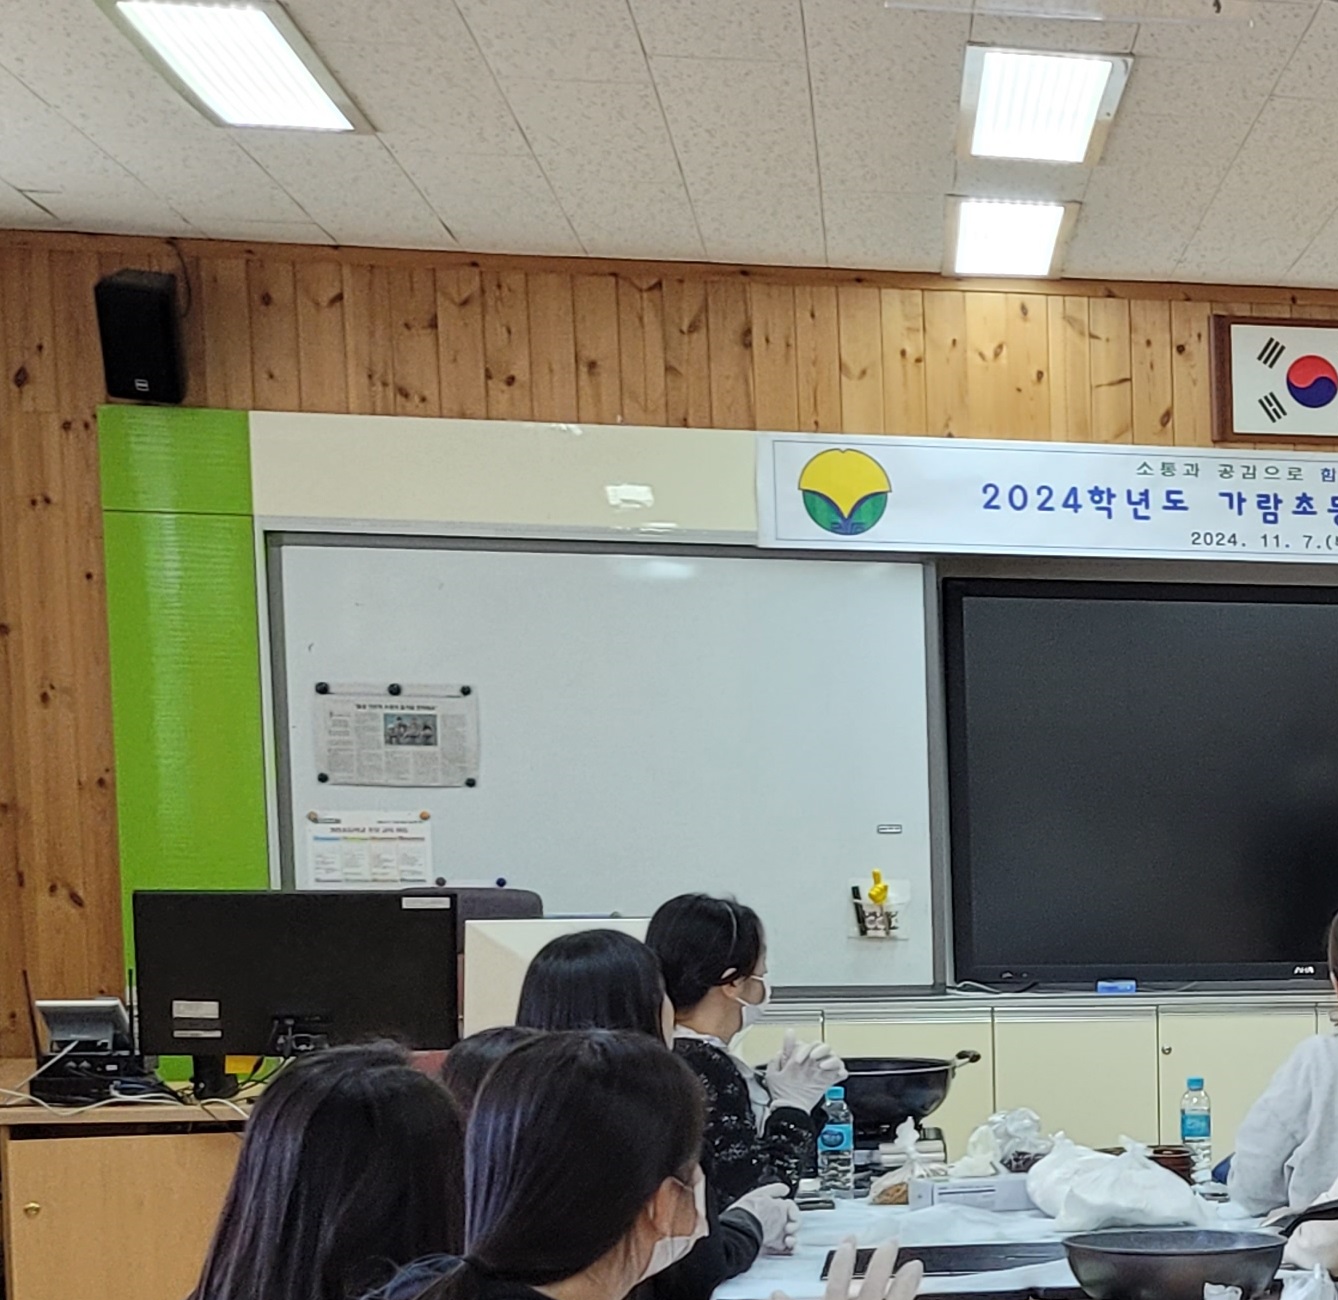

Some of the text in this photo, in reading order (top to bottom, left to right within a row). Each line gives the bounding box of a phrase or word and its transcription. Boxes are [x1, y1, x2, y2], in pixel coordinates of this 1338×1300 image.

[1135, 461, 1200, 478] 소통과
[1218, 464, 1304, 481] 공감으로
[982, 482, 1190, 521] 2024학년도
[1190, 532, 1247, 548] 2024.
[1260, 534, 1291, 549] 11.
